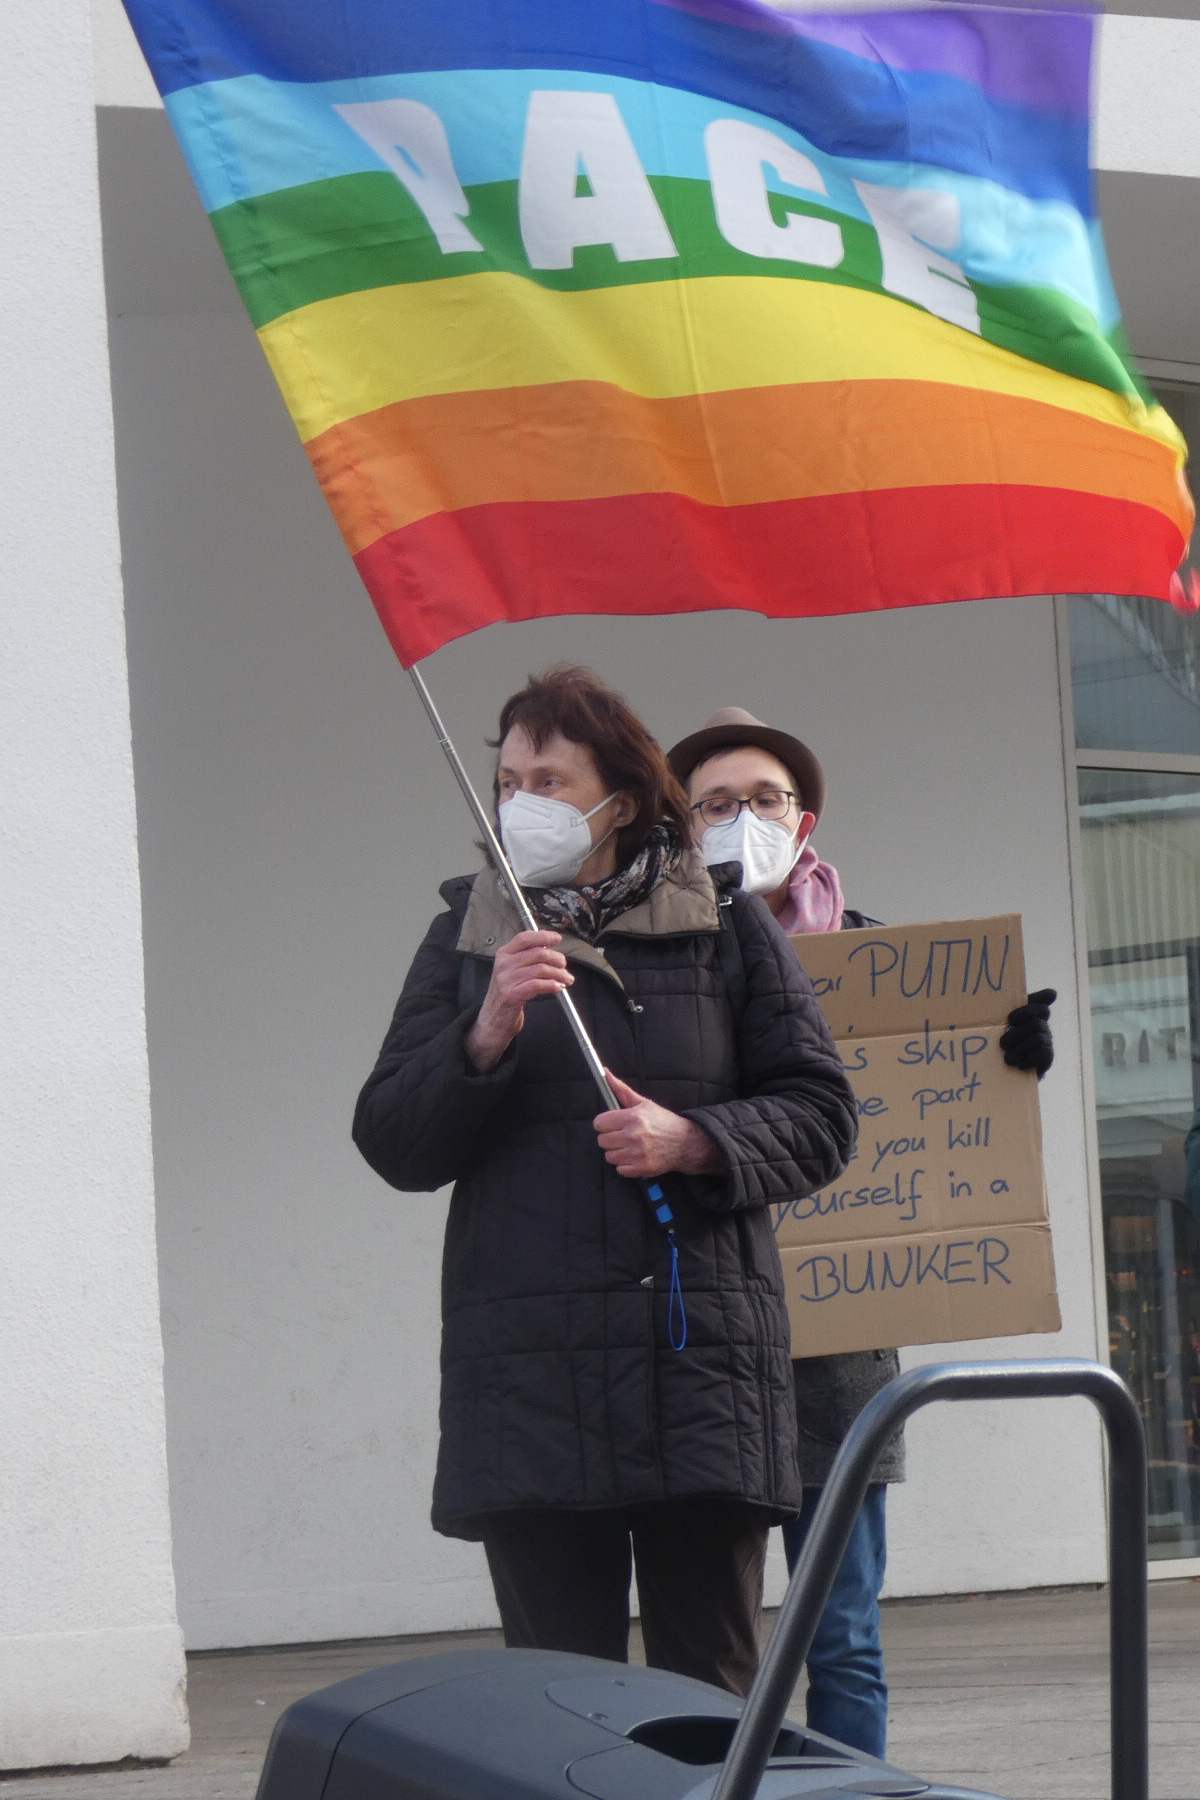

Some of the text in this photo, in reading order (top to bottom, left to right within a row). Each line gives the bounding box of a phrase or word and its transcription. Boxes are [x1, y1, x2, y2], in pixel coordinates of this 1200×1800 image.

[333, 90, 981, 335] PACE
[898, 1019, 989, 1077] skip
[912, 1071, 982, 1120] part
[871, 1137, 927, 1172] you
[948, 1117, 991, 1149] kill
[772, 1169, 1010, 1234] yourself in a
[797, 1237, 1012, 1302] BUNKER
